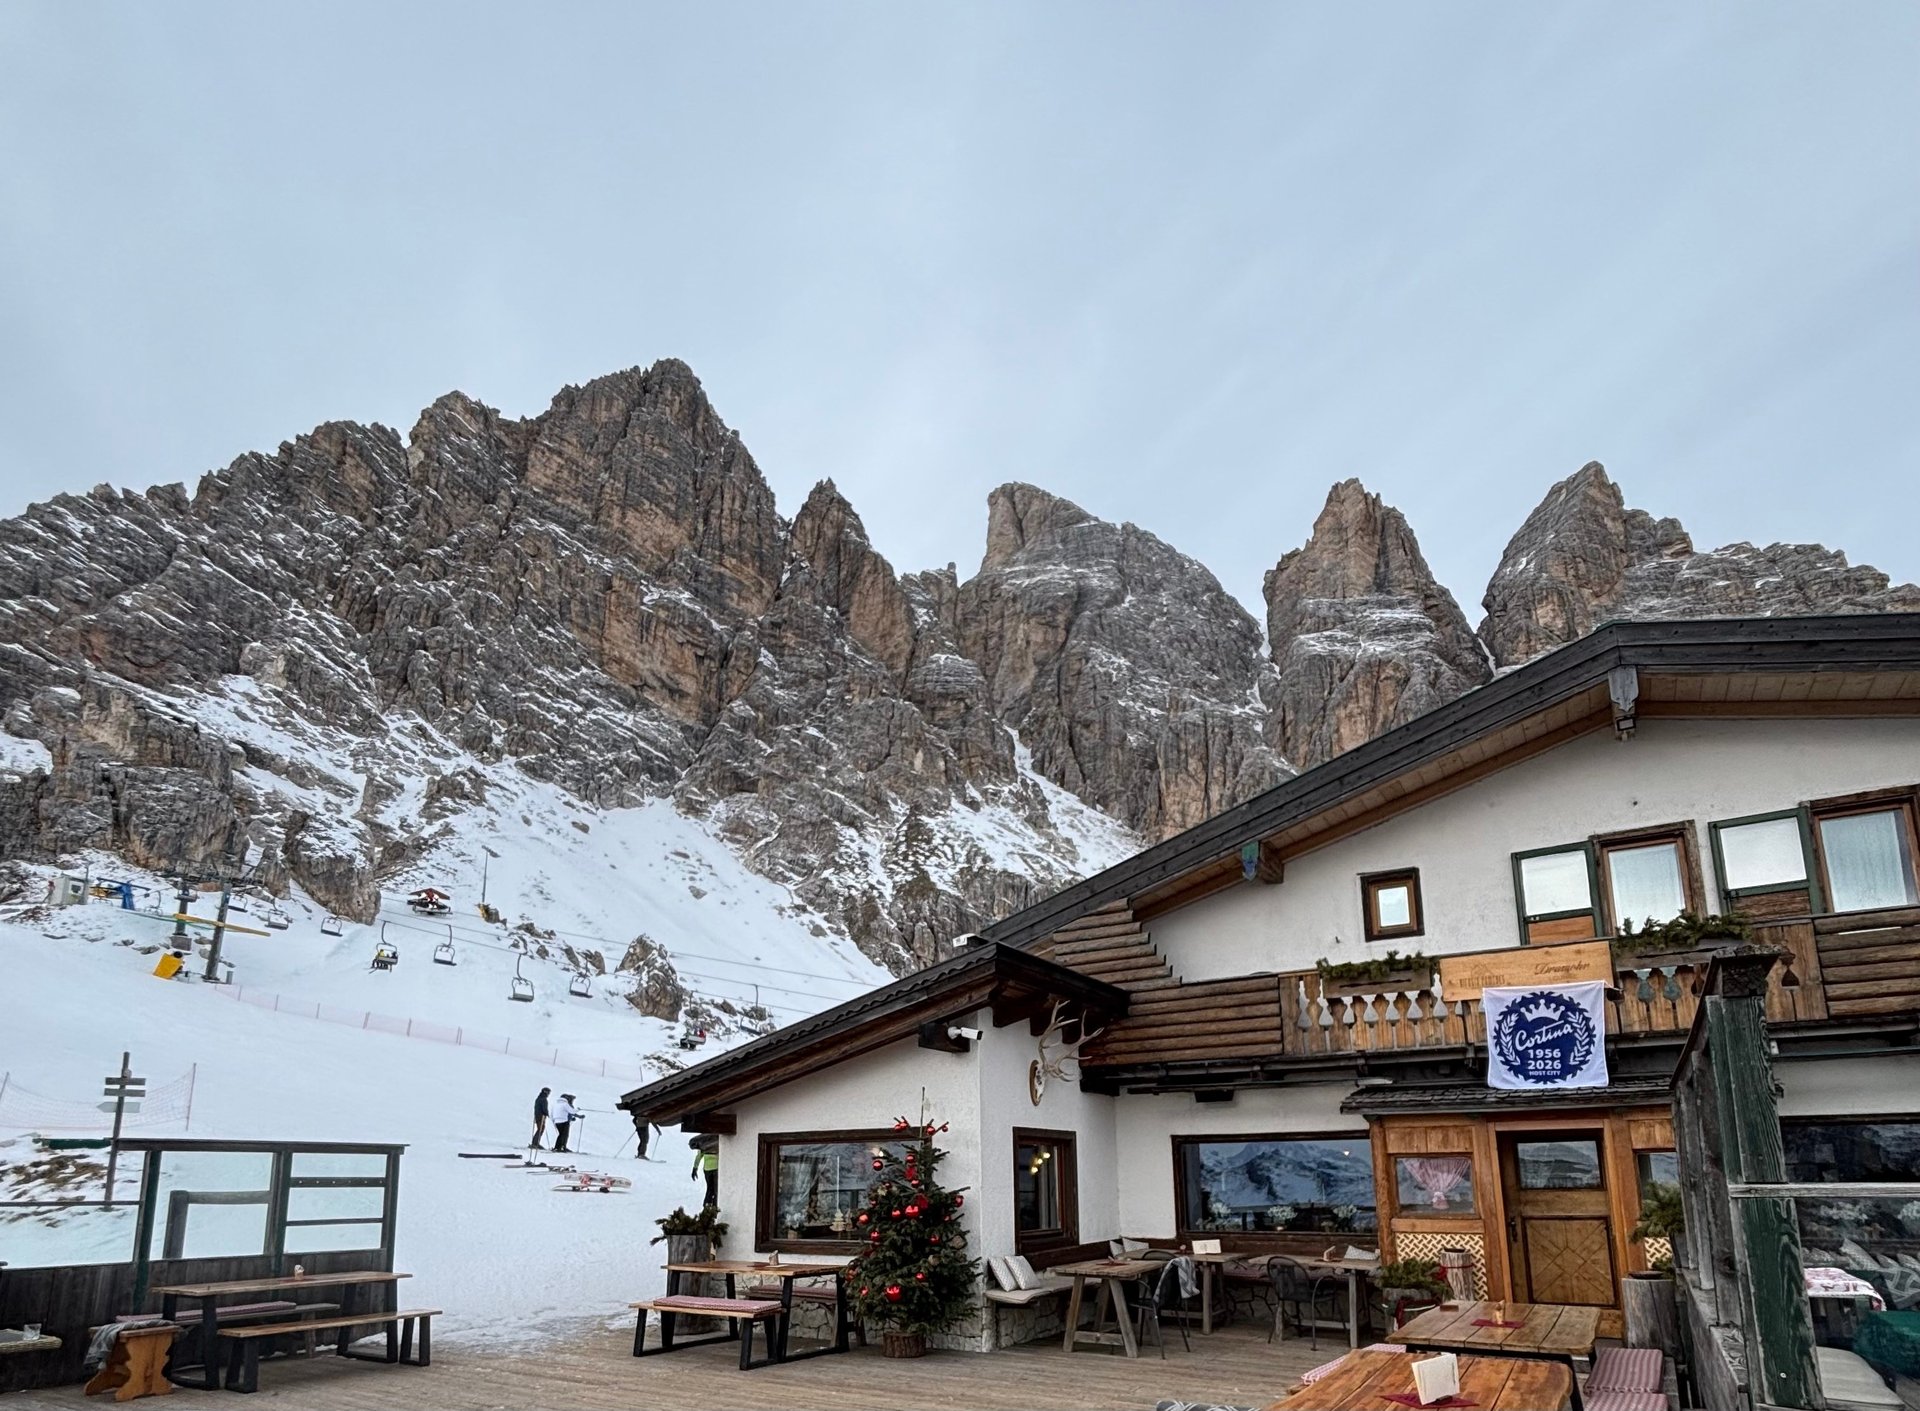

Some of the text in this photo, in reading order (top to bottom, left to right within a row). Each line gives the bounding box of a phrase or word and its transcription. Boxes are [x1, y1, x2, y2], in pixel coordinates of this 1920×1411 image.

[1515, 1020, 1573, 1051] Cortina
[1528, 1048, 1561, 1058] 1956
[1528, 1060, 1561, 1069] 2026
